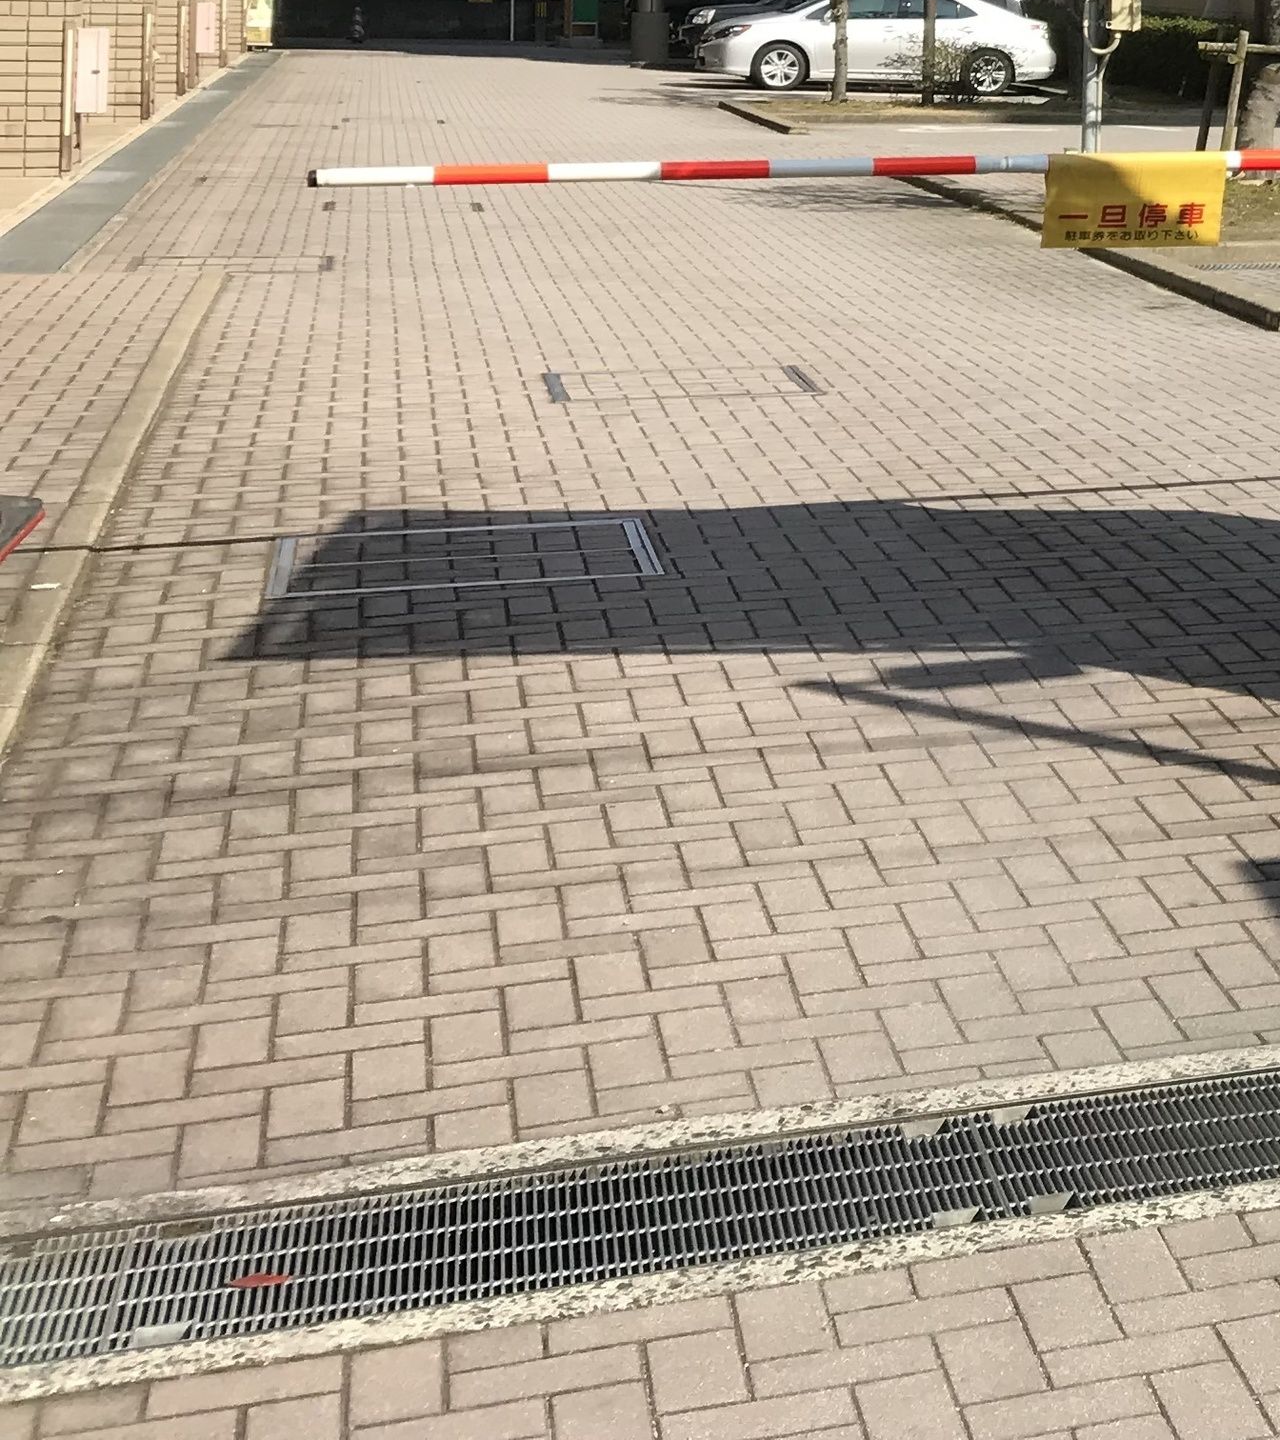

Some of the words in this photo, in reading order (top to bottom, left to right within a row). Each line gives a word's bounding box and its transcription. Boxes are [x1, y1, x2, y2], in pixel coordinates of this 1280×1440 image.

[1058, 202, 1207, 229] 一旦停車
[1064, 229, 1200, 243] 駐車券をお取り下さい
